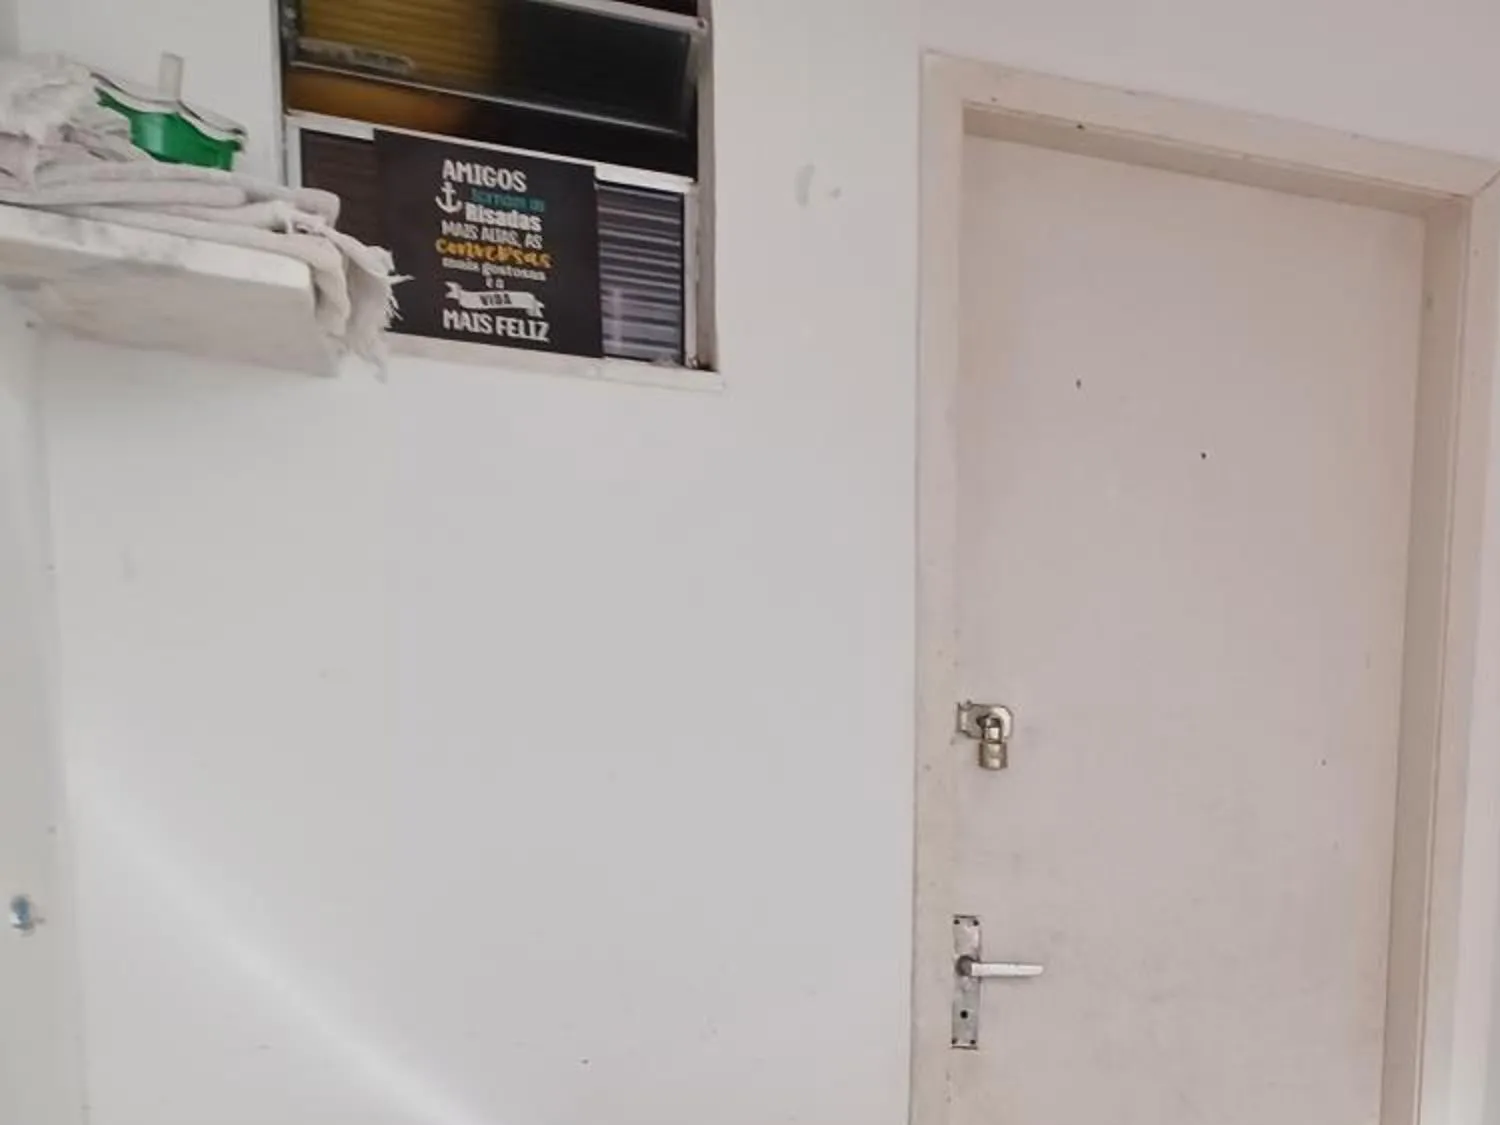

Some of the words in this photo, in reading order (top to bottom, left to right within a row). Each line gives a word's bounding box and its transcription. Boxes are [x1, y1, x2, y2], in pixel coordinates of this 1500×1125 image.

[442, 158, 528, 193] AMIGOS
[441, 219, 479, 241] MAIS
[443, 308, 493, 335] MAIS
[495, 315, 551, 343] FELIZ
